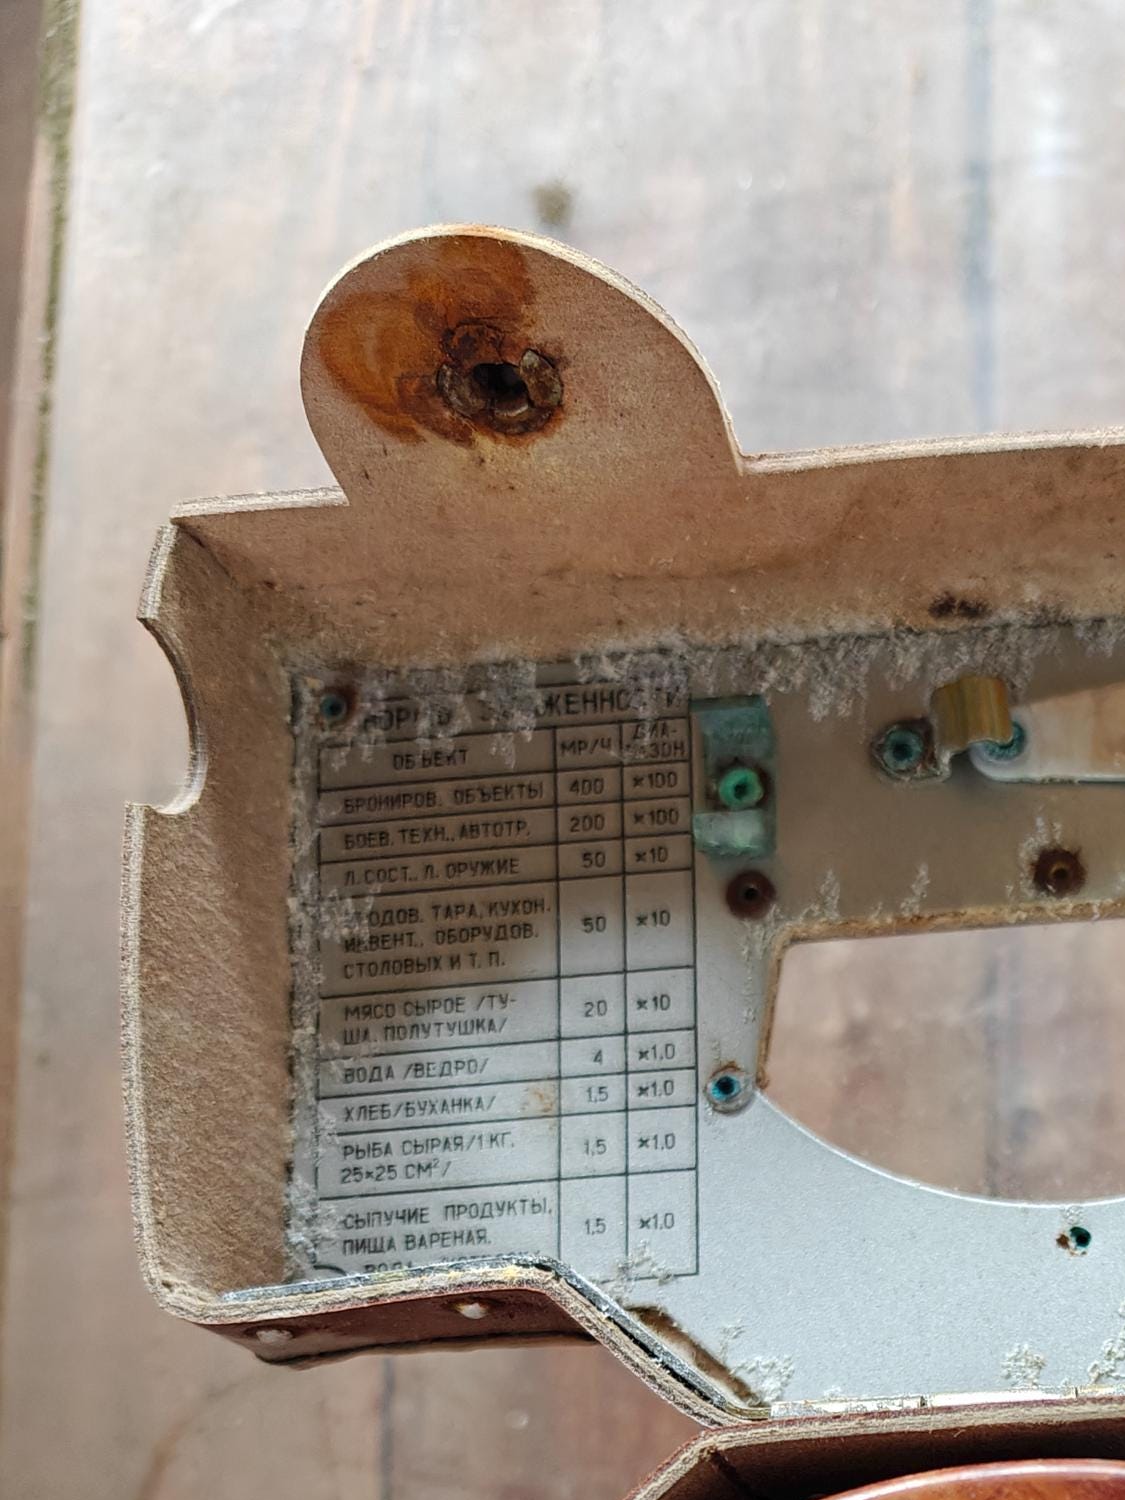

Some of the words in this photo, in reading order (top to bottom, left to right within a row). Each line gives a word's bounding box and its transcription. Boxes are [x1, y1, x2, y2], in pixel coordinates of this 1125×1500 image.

[453, 781, 544, 806] ОБЪЕКТЫ
[569, 778, 605, 797] 400
[569, 814, 606, 833] 200
[445, 858, 521, 880] ОРУЖИЕ
[581, 851, 606, 869] 50
[581, 916, 607, 934] 50
[344, 955, 444, 980] СТОЛОВЫХ
[449, 954, 462, 970] И
[344, 1003, 396, 1022] МЯСО
[403, 996, 466, 1018] СЫРОЕ
[584, 1000, 608, 1018] 20
[343, 1065, 395, 1084] ВОДА
[403, 1057, 489, 1082] /ВЕДРО/
[592, 1049, 604, 1066] 4
[343, 1141, 393, 1160] РЫБА
[343, 1207, 430, 1230] СЫПУЧИЕ
[343, 1237, 396, 1256] ПИЩА
